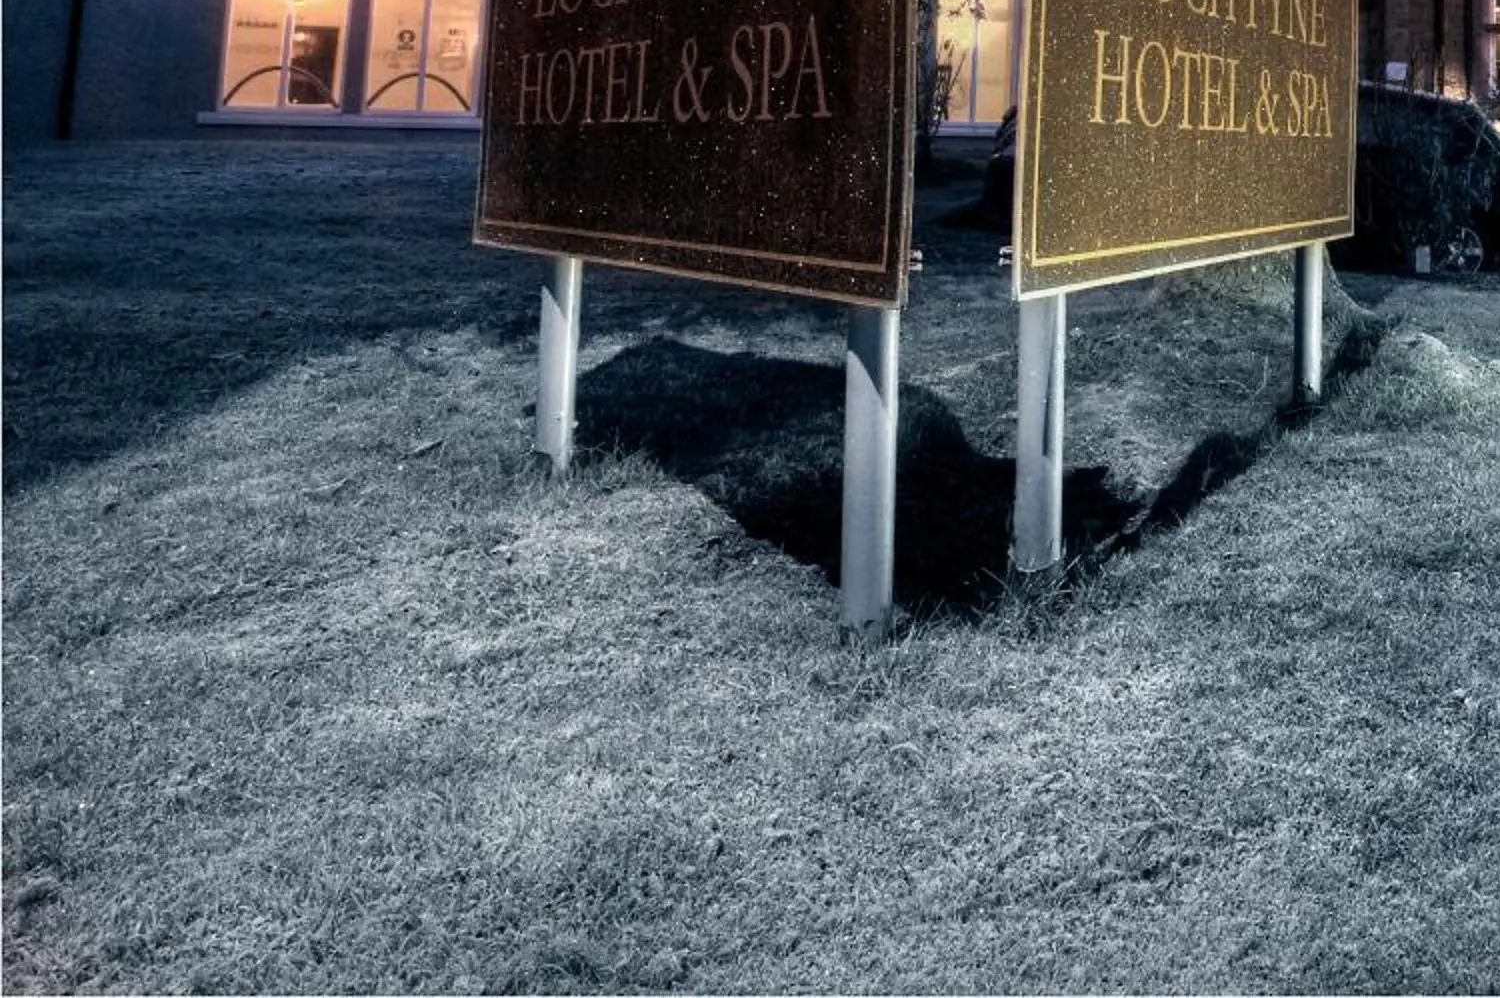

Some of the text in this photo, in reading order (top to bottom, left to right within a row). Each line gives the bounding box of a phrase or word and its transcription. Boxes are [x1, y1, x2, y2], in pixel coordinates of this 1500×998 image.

[516, 13, 833, 126] HOTEL & SPA
[1088, 28, 1333, 138] HOTEL & SPA
